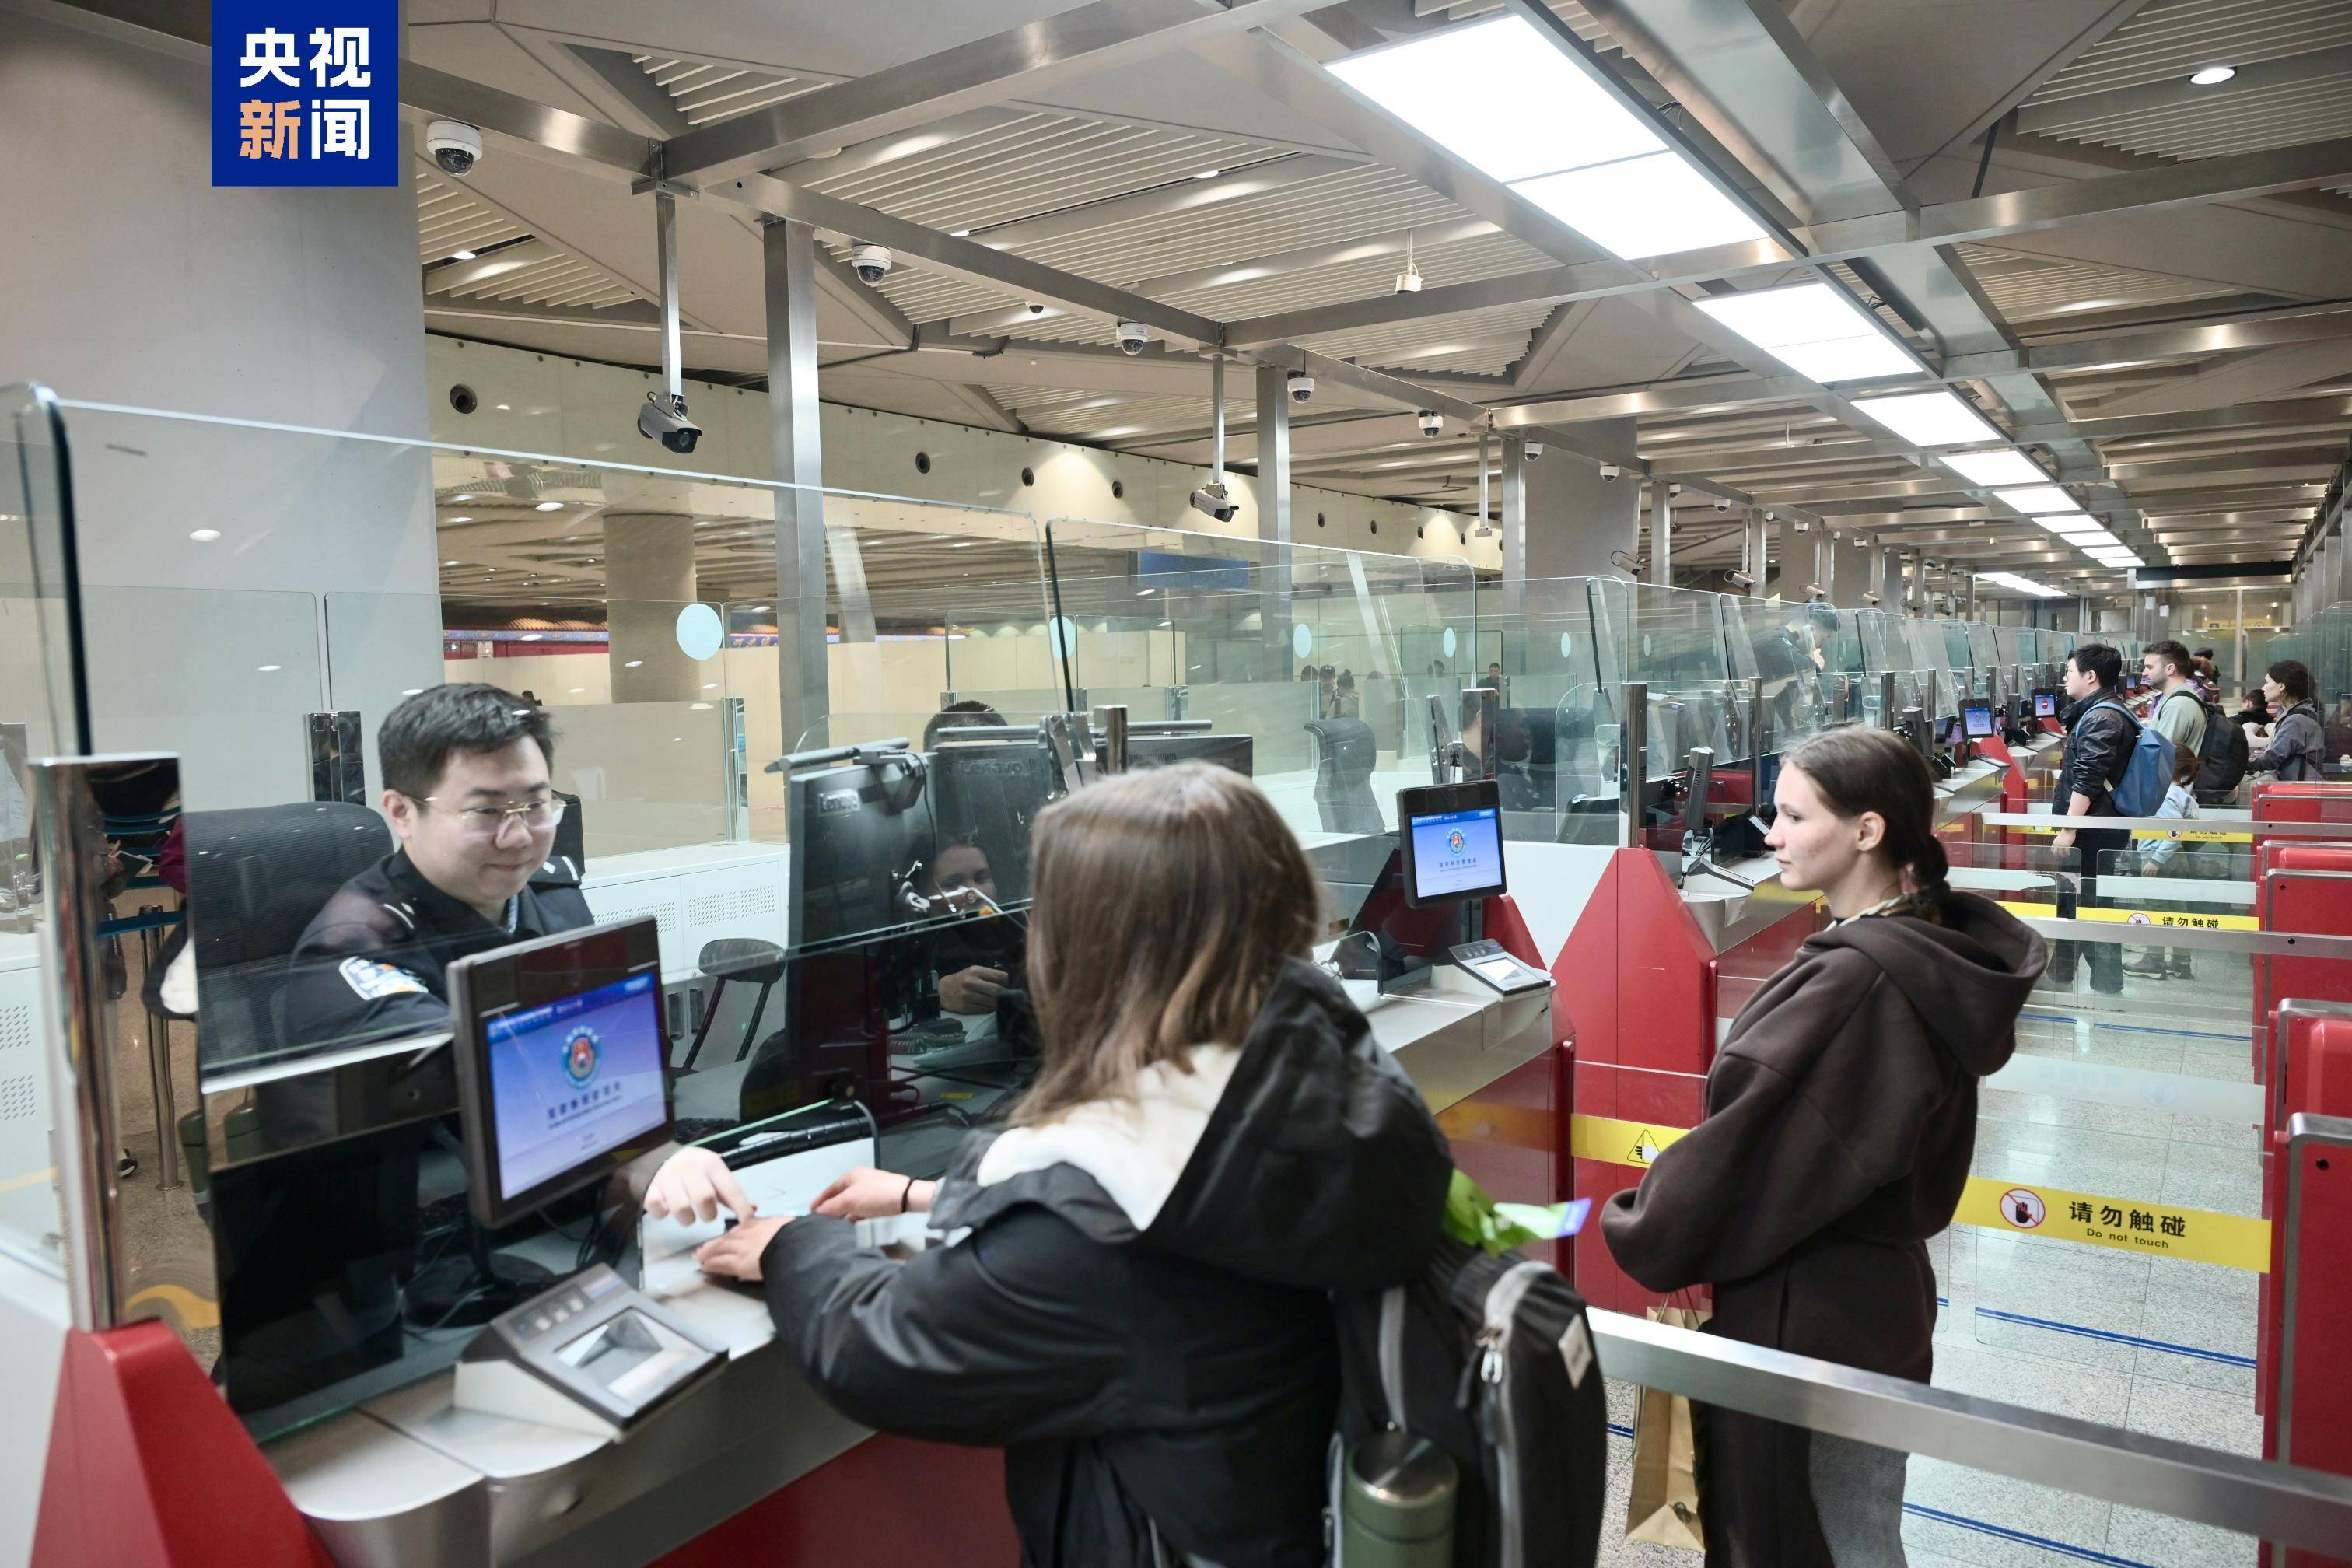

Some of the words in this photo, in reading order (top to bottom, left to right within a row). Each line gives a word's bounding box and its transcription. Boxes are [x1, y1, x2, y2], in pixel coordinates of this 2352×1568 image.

[2161, 916, 2219, 929] 请勿触碰
[2069, 1201, 2186, 1237] 请勿触碰
[2086, 1228, 2102, 1238] Do
[2109, 1233, 2128, 1242] not
[2134, 1237, 2169, 1248] touch
